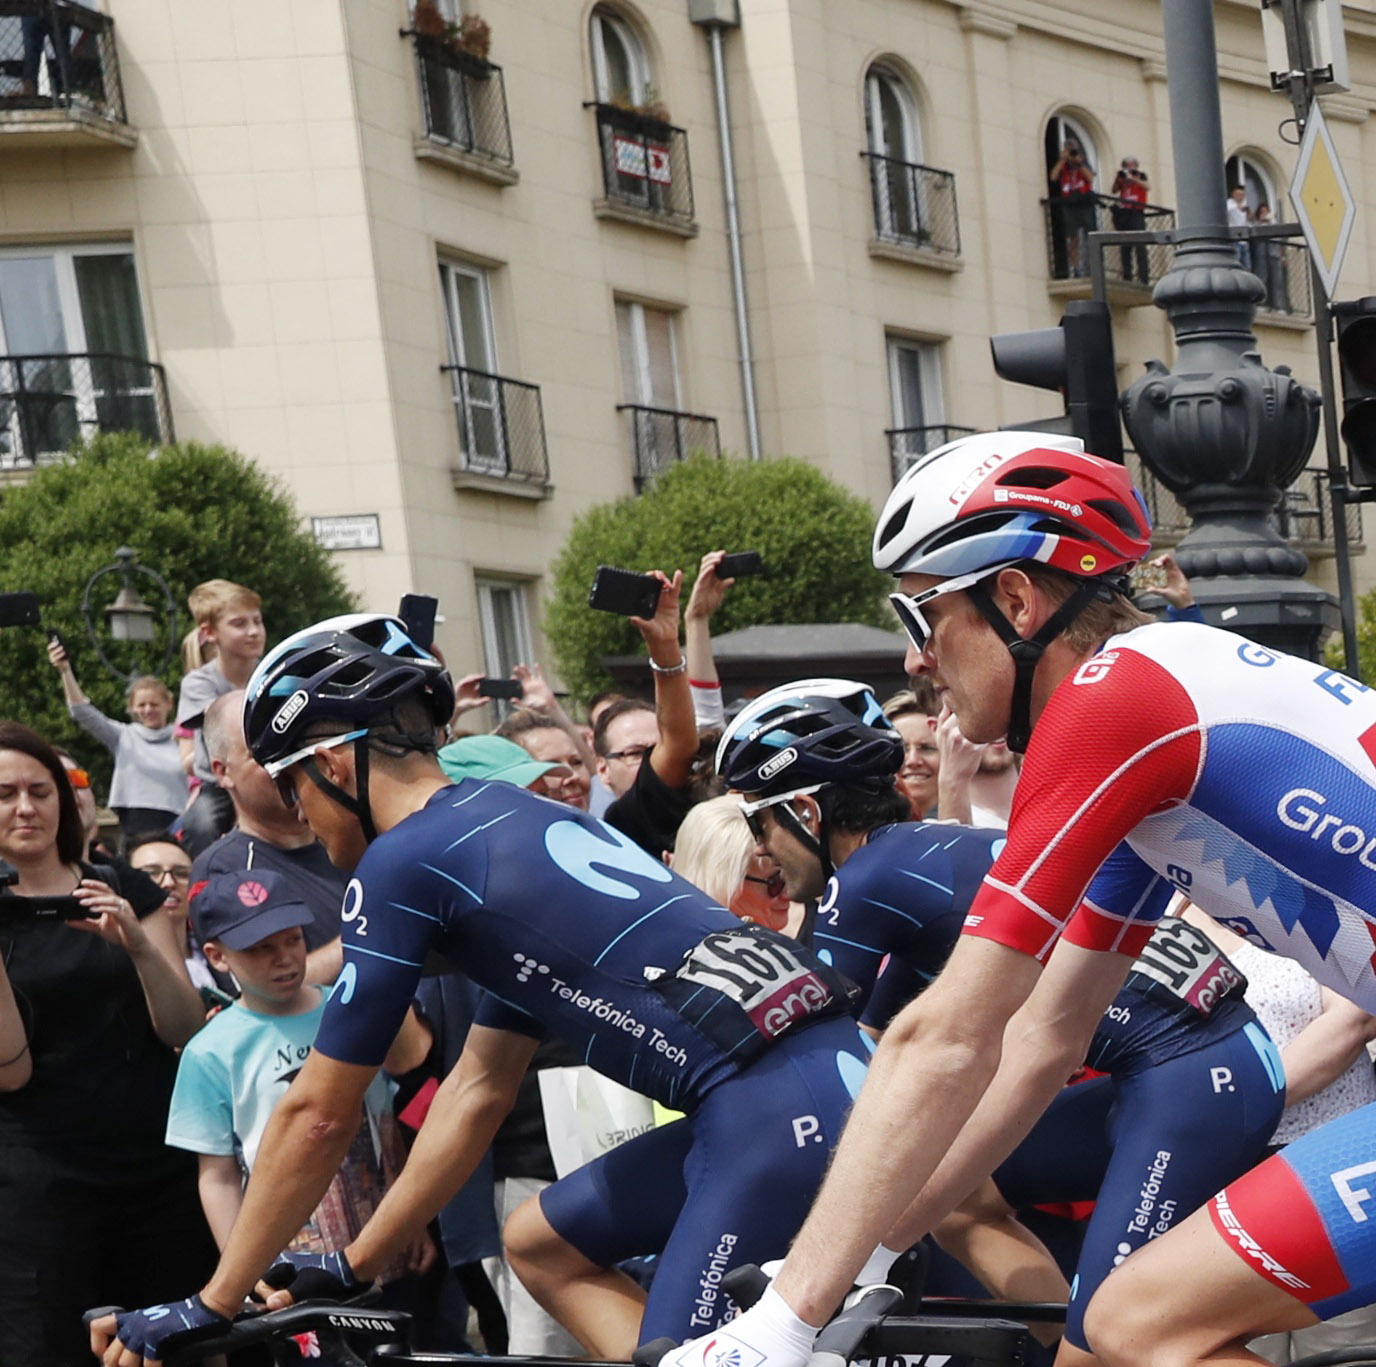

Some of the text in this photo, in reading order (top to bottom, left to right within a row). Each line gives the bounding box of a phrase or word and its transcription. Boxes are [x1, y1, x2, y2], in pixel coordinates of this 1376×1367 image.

[276, 692, 306, 730] ABUS
[763, 751, 793, 778] ABUS
[550, 977, 689, 1068] Telefónica Tech
[763, 974, 828, 1037] enel
[1127, 1149, 1172, 1236] Telefónica
[1148, 1197, 1178, 1241] Tech
[1210, 1188, 1312, 1291] PIERRE
[690, 1232, 739, 1328] Telefónica
[328, 1314, 396, 1333] CANYON
